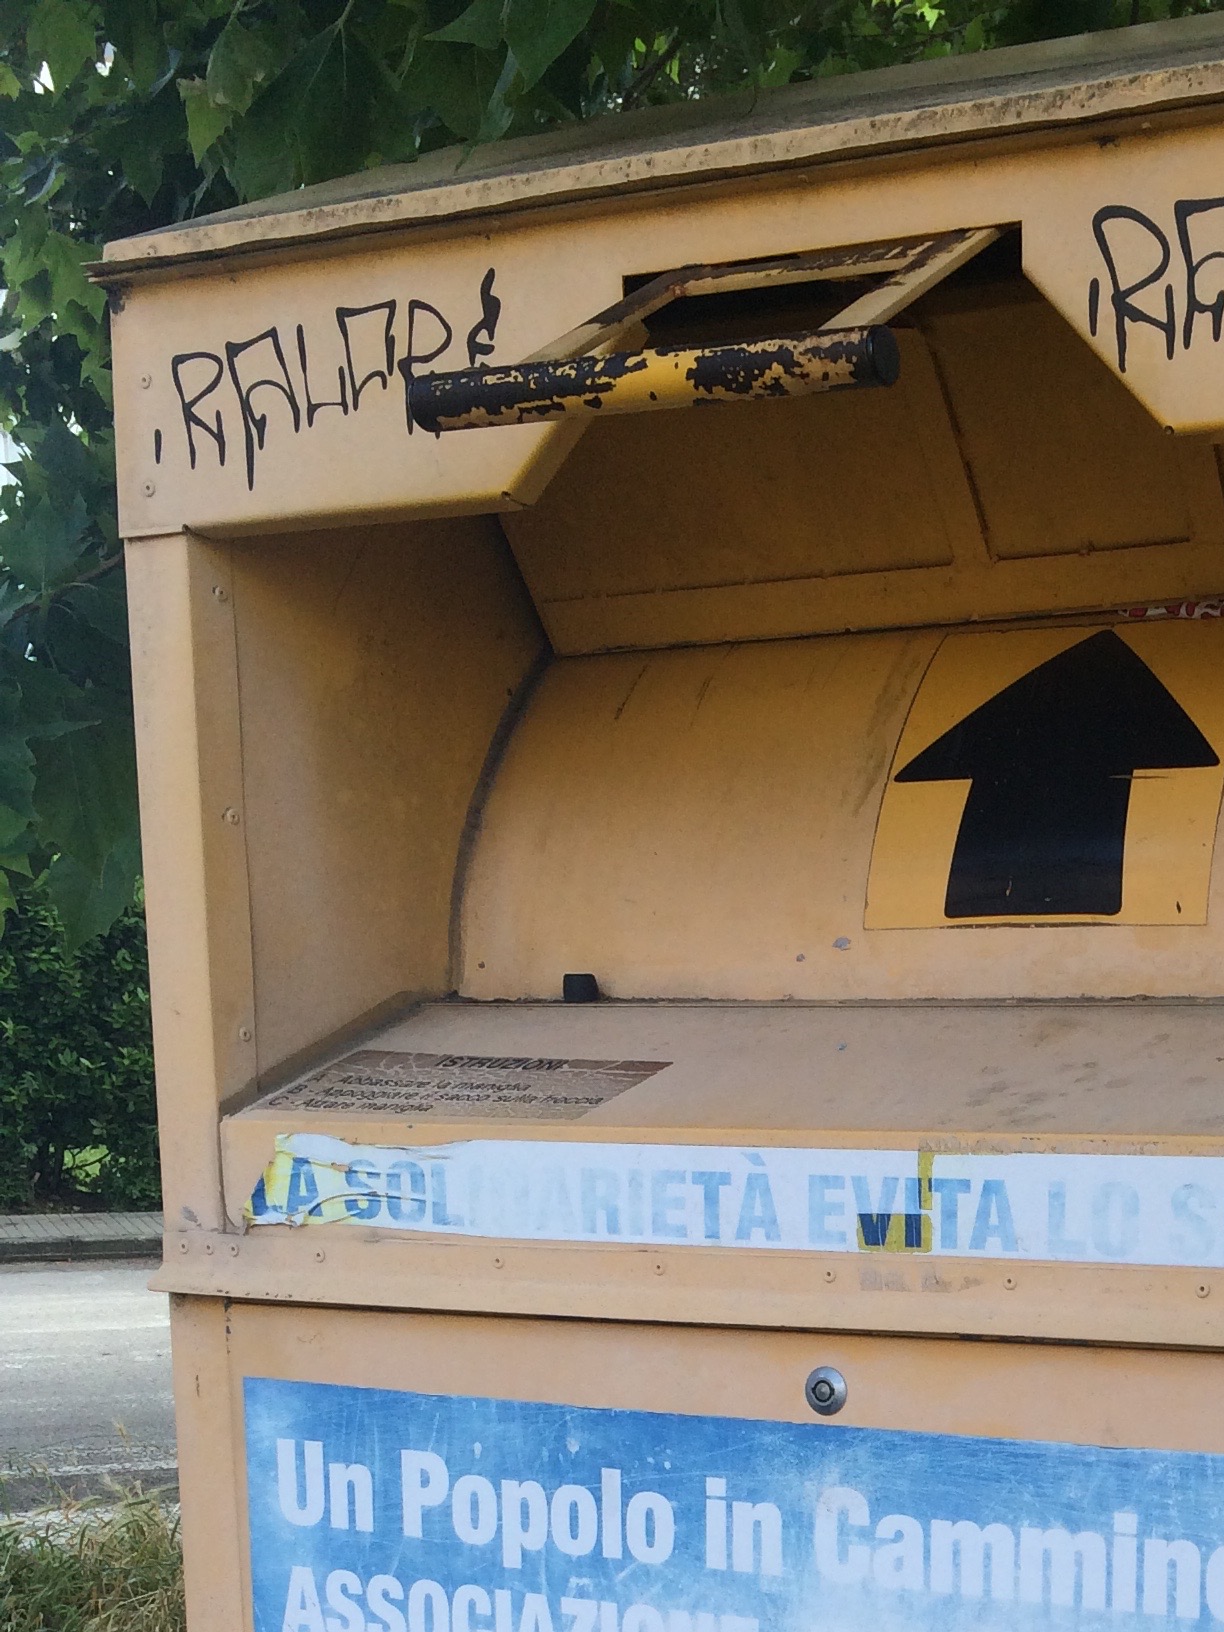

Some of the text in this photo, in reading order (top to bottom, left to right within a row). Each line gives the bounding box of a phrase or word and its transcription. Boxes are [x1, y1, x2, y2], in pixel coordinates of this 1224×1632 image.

[435, 1055, 569, 1070] ISTRUZIONI
[808, 1174, 1019, 1252] EVITA
[1047, 1179, 1141, 1260] LO
[276, 1438, 374, 1532] Un
[400, 1449, 675, 1569] Popolo
[704, 1476, 783, 1577] in
